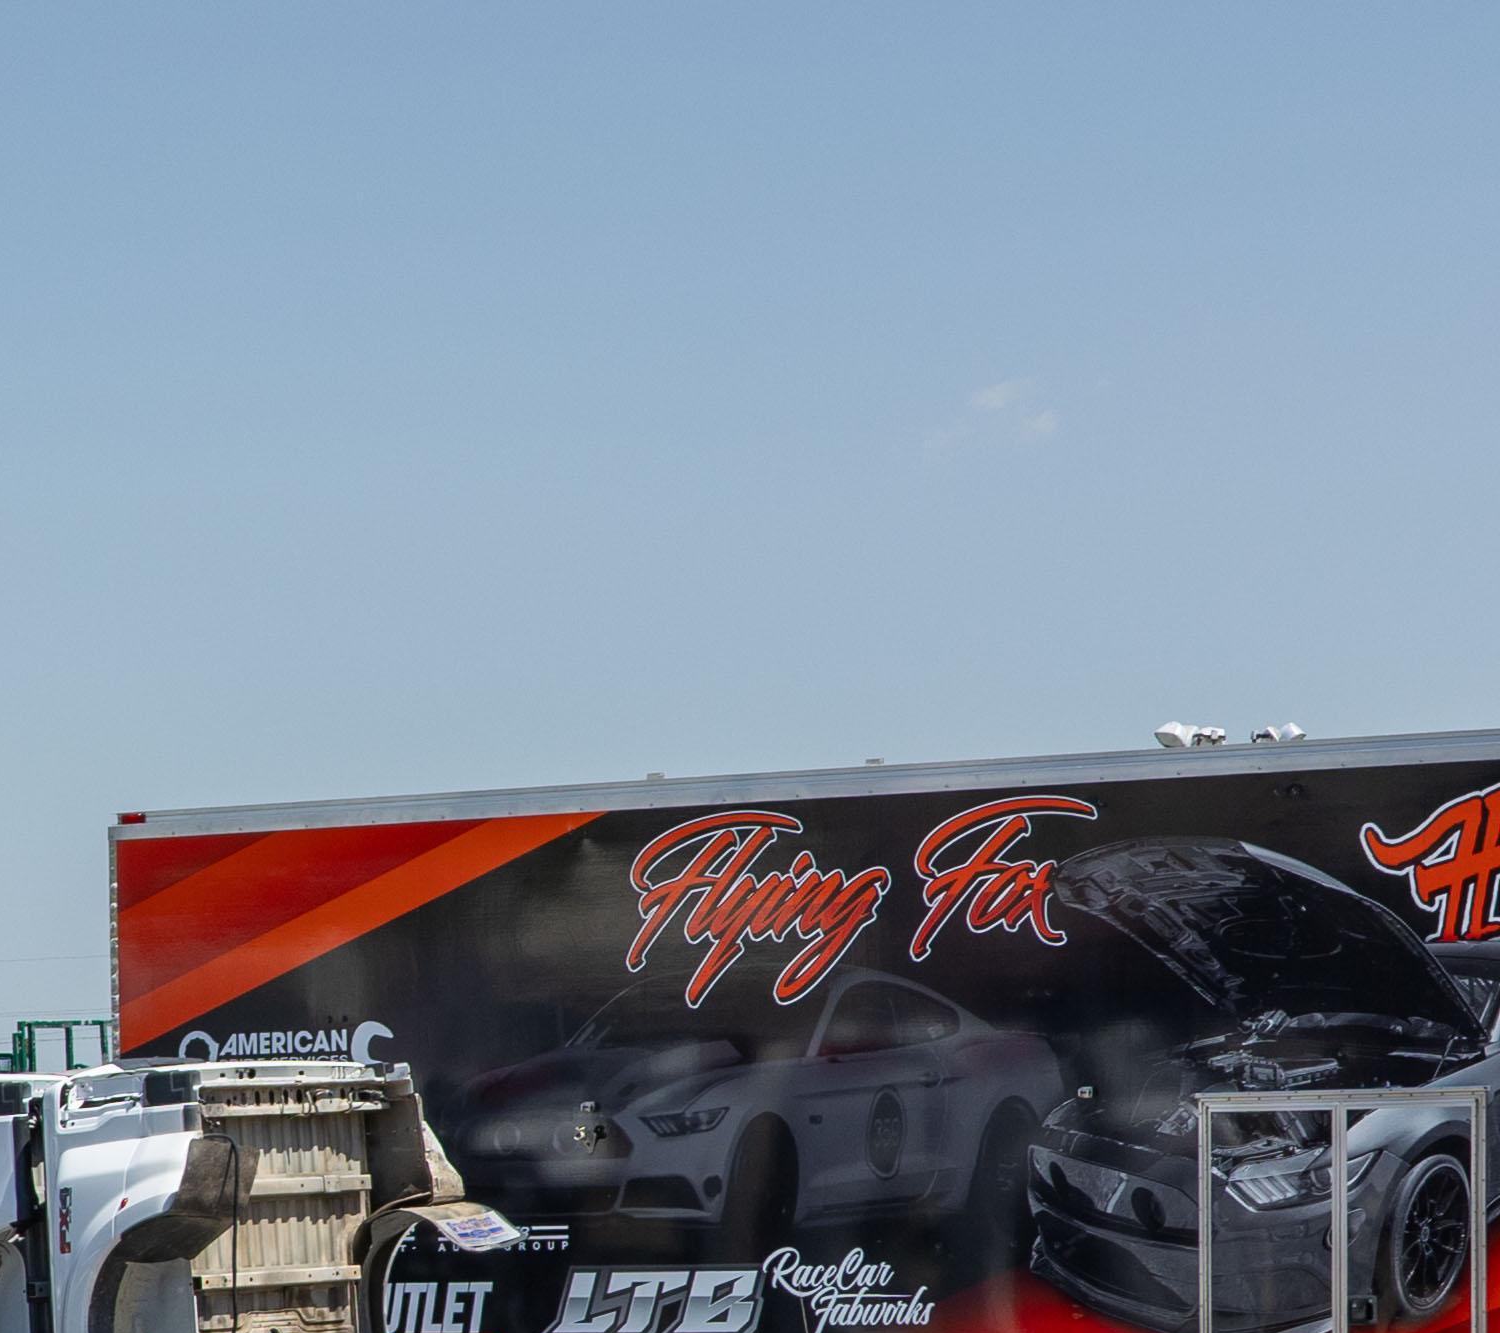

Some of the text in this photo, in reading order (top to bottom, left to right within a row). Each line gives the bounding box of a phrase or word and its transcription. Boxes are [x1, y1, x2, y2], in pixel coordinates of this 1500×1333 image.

[627, 796, 1097, 1008] Flying Fox
[219, 1028, 348, 1056] AMERICAN
[504, 1241, 570, 1252] ROUP
[763, 1246, 895, 1297] RaceCar
